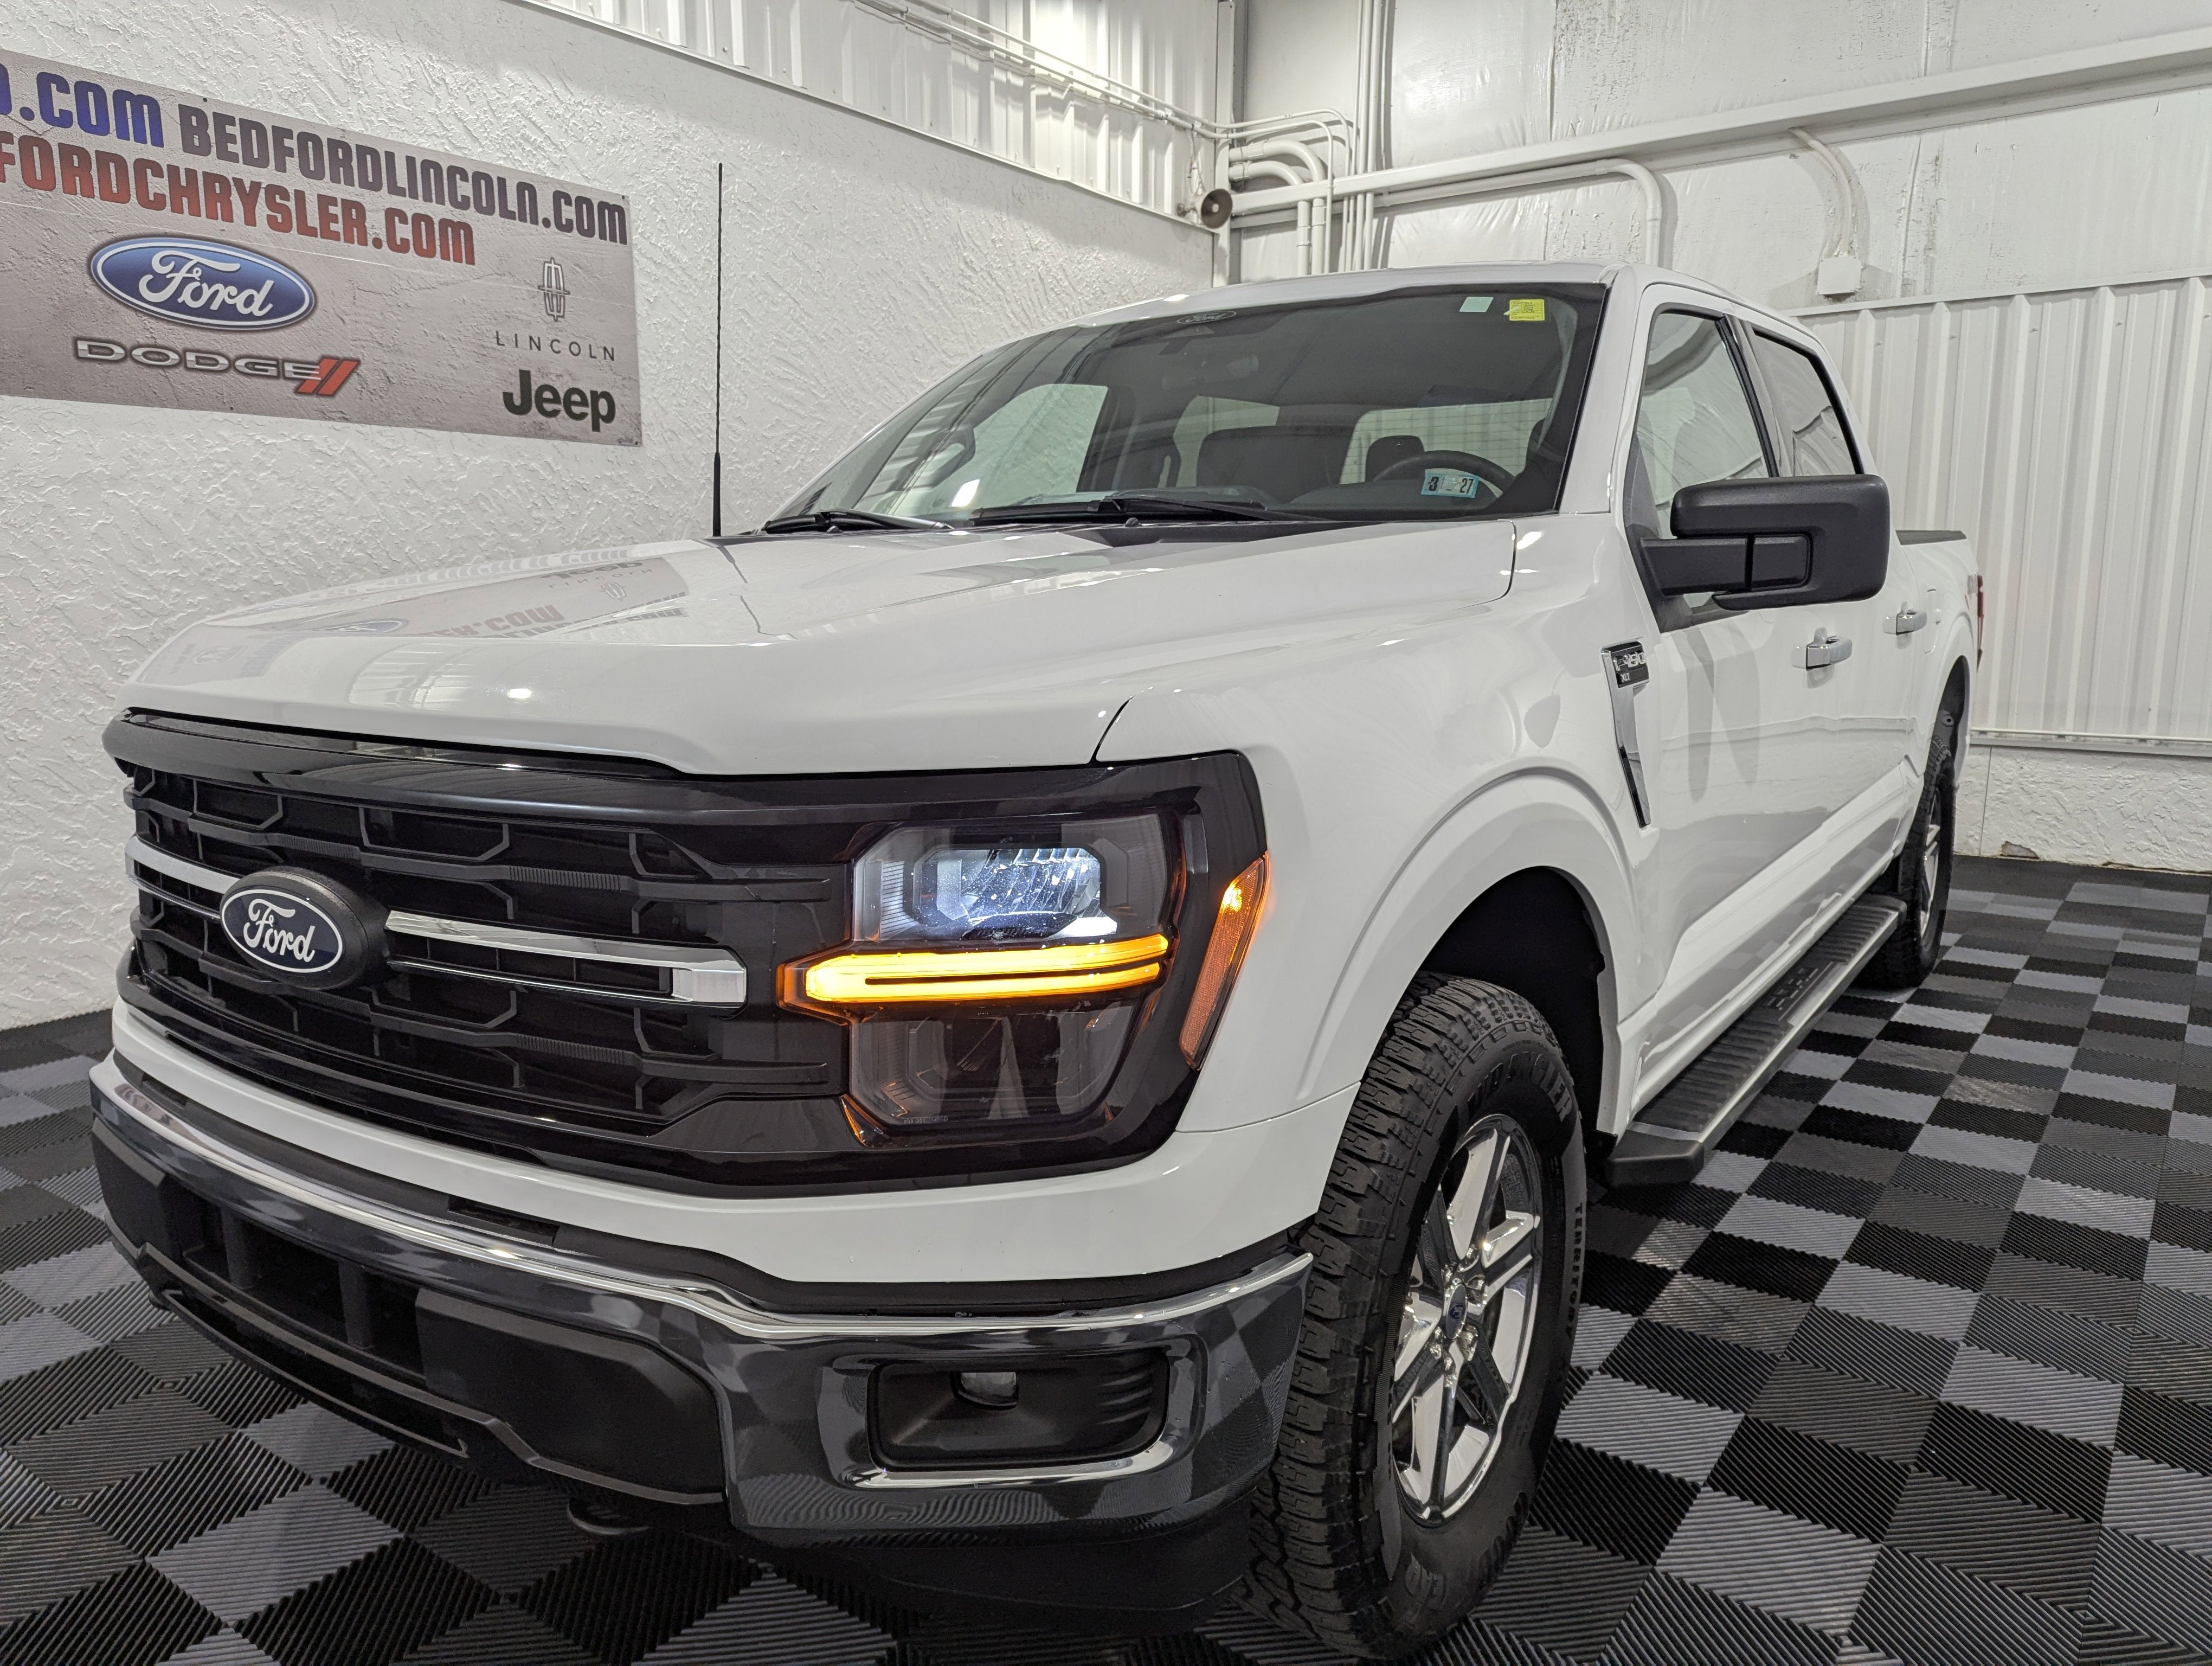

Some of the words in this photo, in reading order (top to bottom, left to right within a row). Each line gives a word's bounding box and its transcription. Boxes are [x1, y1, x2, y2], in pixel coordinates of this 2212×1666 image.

[178, 104, 627, 245] BEDFORDLINCOLN.COM
[139, 250, 274, 316] Ford
[77, 340, 321, 380] DODGE
[496, 331, 614, 361] LINCOLN
[502, 369, 616, 433] Jeep
[1429, 476, 1439, 492] 3
[1459, 478, 1474, 495] 27
[1620, 672, 1630, 682] XLT
[243, 899, 315, 963] Ford
